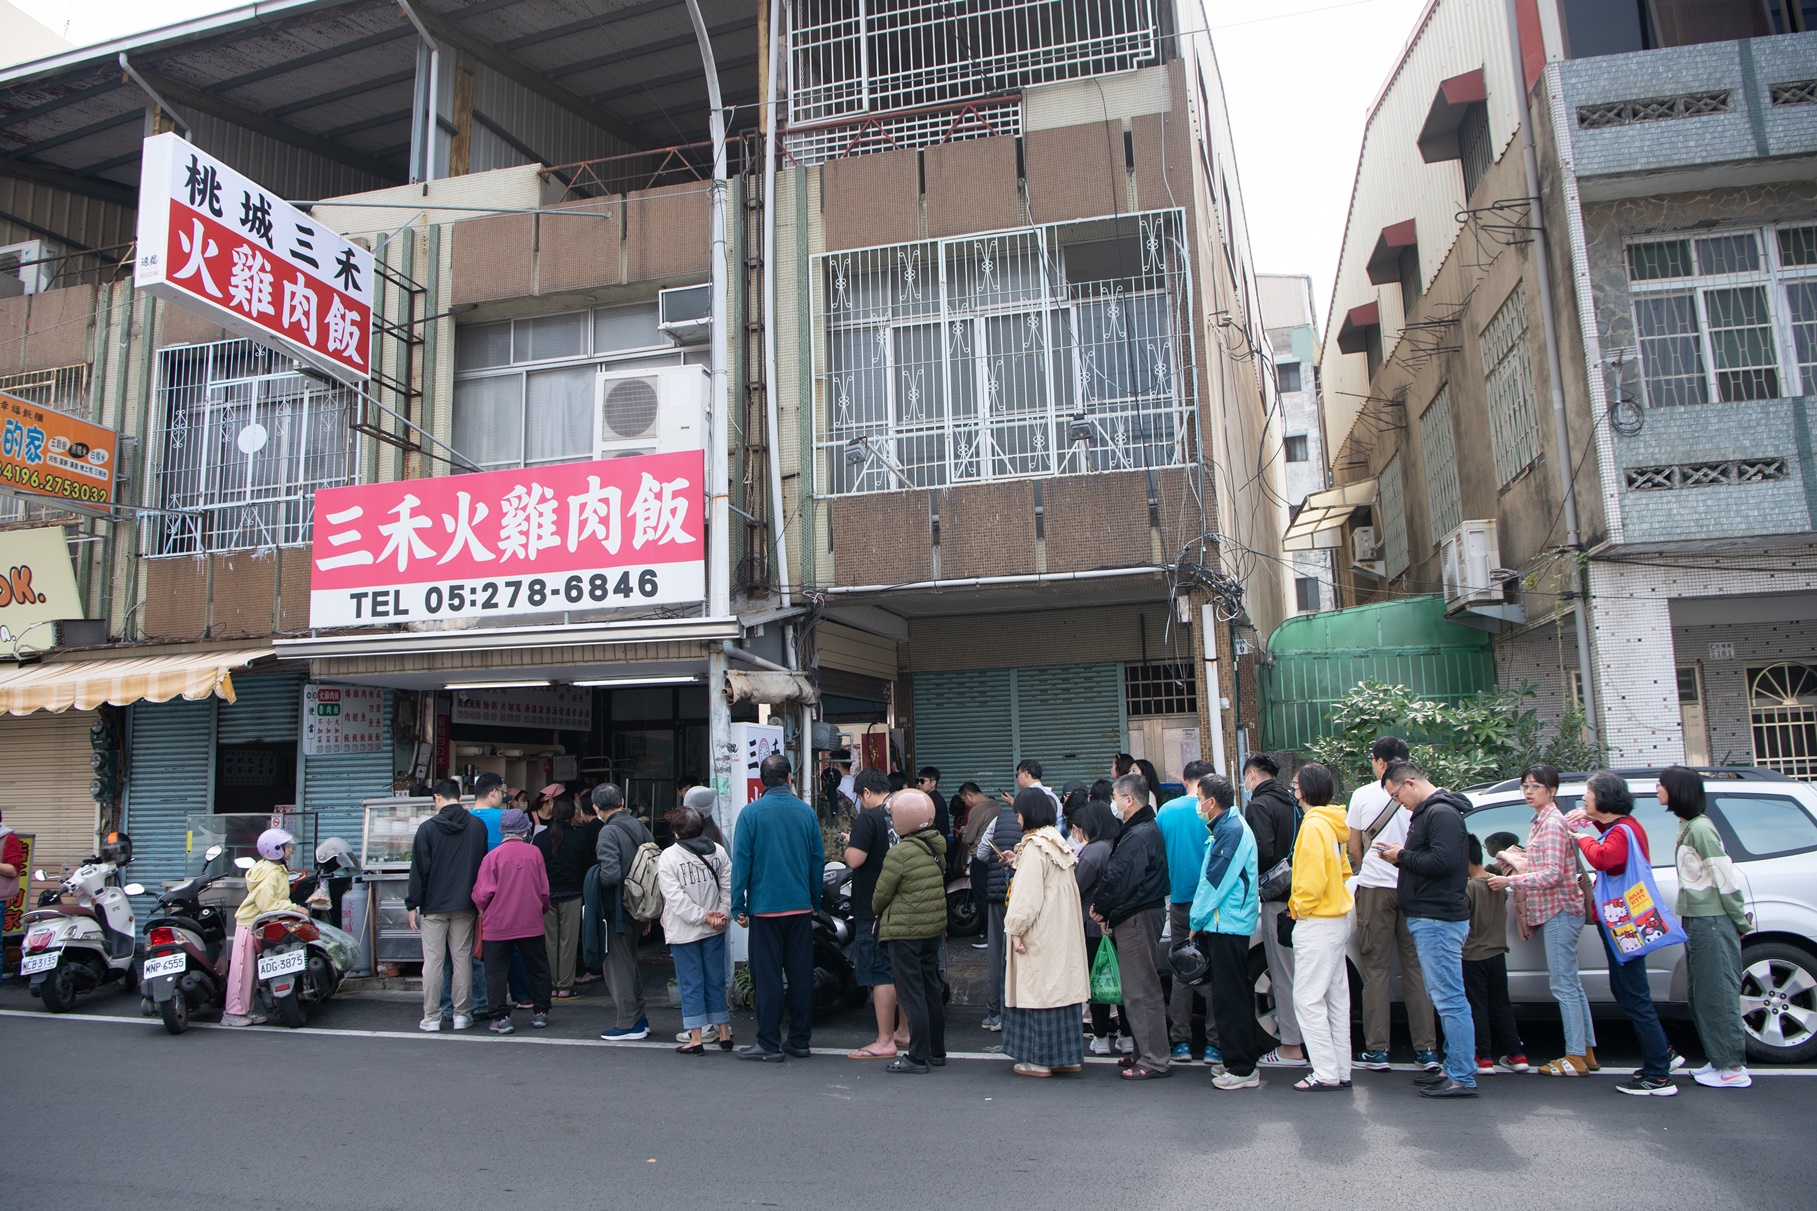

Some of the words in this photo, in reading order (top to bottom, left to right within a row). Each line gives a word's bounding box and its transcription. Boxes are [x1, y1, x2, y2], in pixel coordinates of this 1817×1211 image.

[184, 153, 363, 293] 桃城三禾
[173, 217, 365, 365] 火雞肉飯
[0, 463, 108, 503] 4196.2753032
[314, 472, 697, 573] 三禾火雞肉飯
[349, 591, 409, 619] TEL
[424, 569, 659, 615] 05:278-6846
[1716, 649, 1732, 657] 101
[145, 957, 184, 975] MNP-6555
[260, 955, 303, 975] ADG-3875
